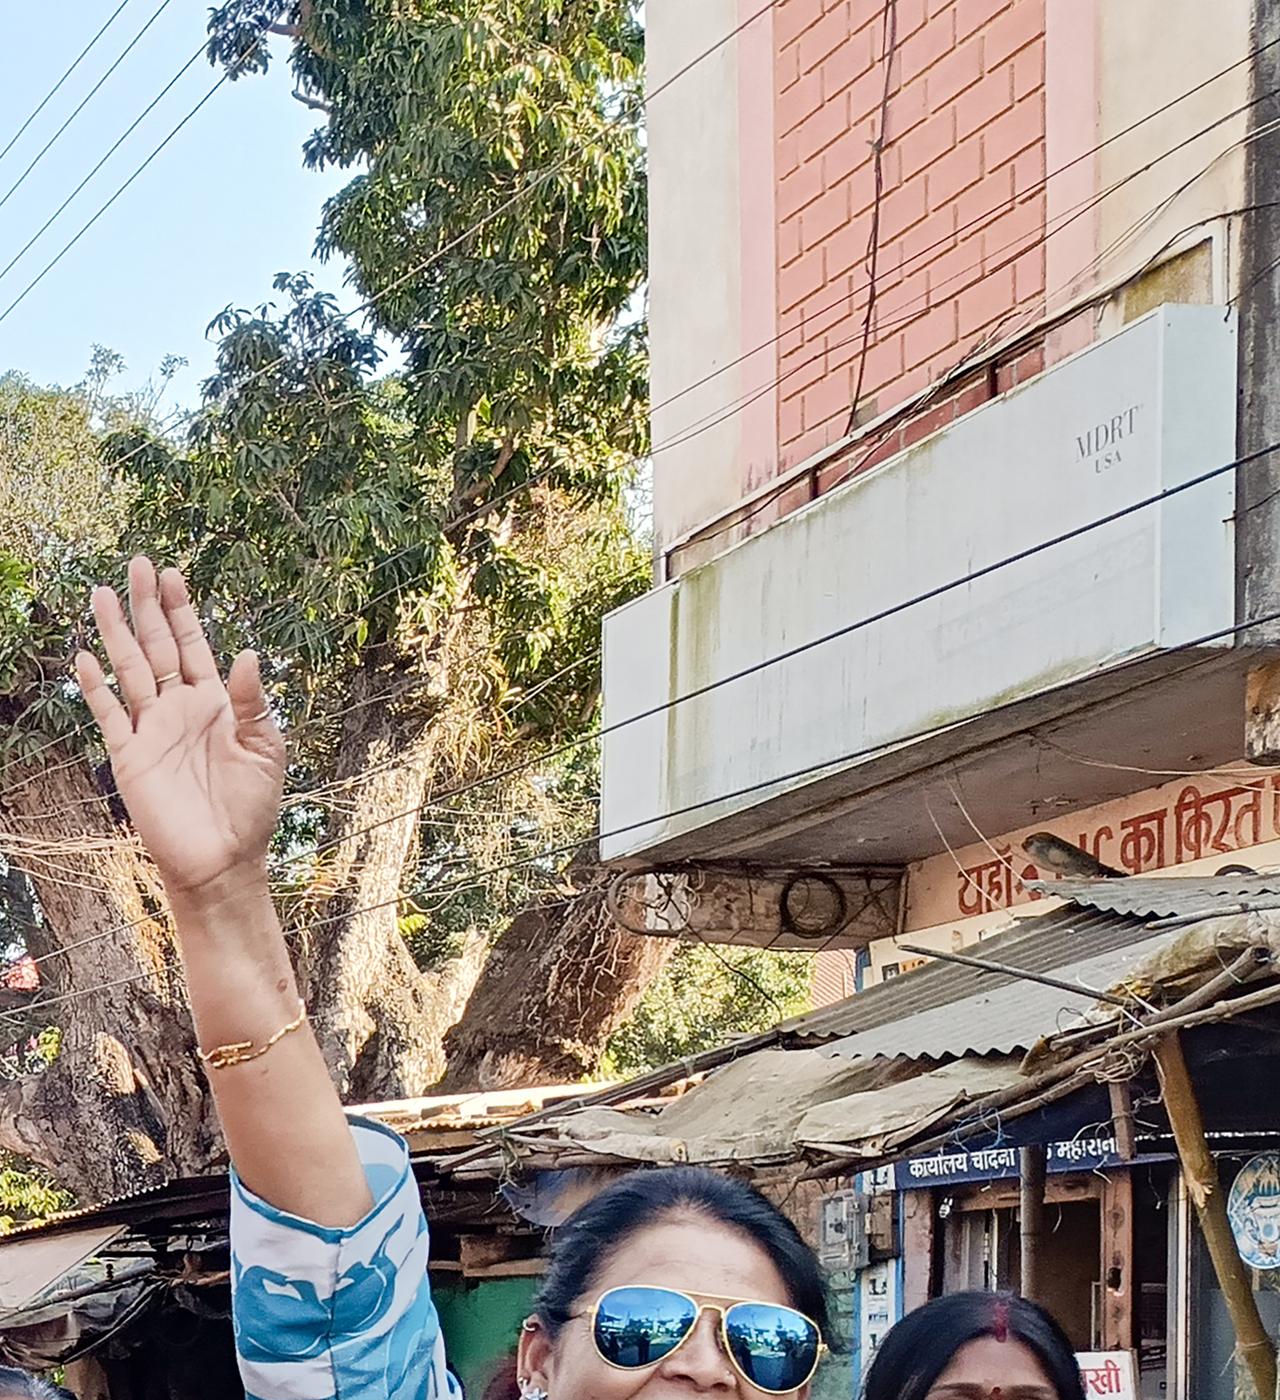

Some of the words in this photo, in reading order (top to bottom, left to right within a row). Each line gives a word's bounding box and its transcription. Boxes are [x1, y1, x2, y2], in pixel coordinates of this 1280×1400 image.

[1075, 405, 1139, 463] MDRT
[1095, 450, 1122, 474] USA
[1121, 807, 1168, 874] का
